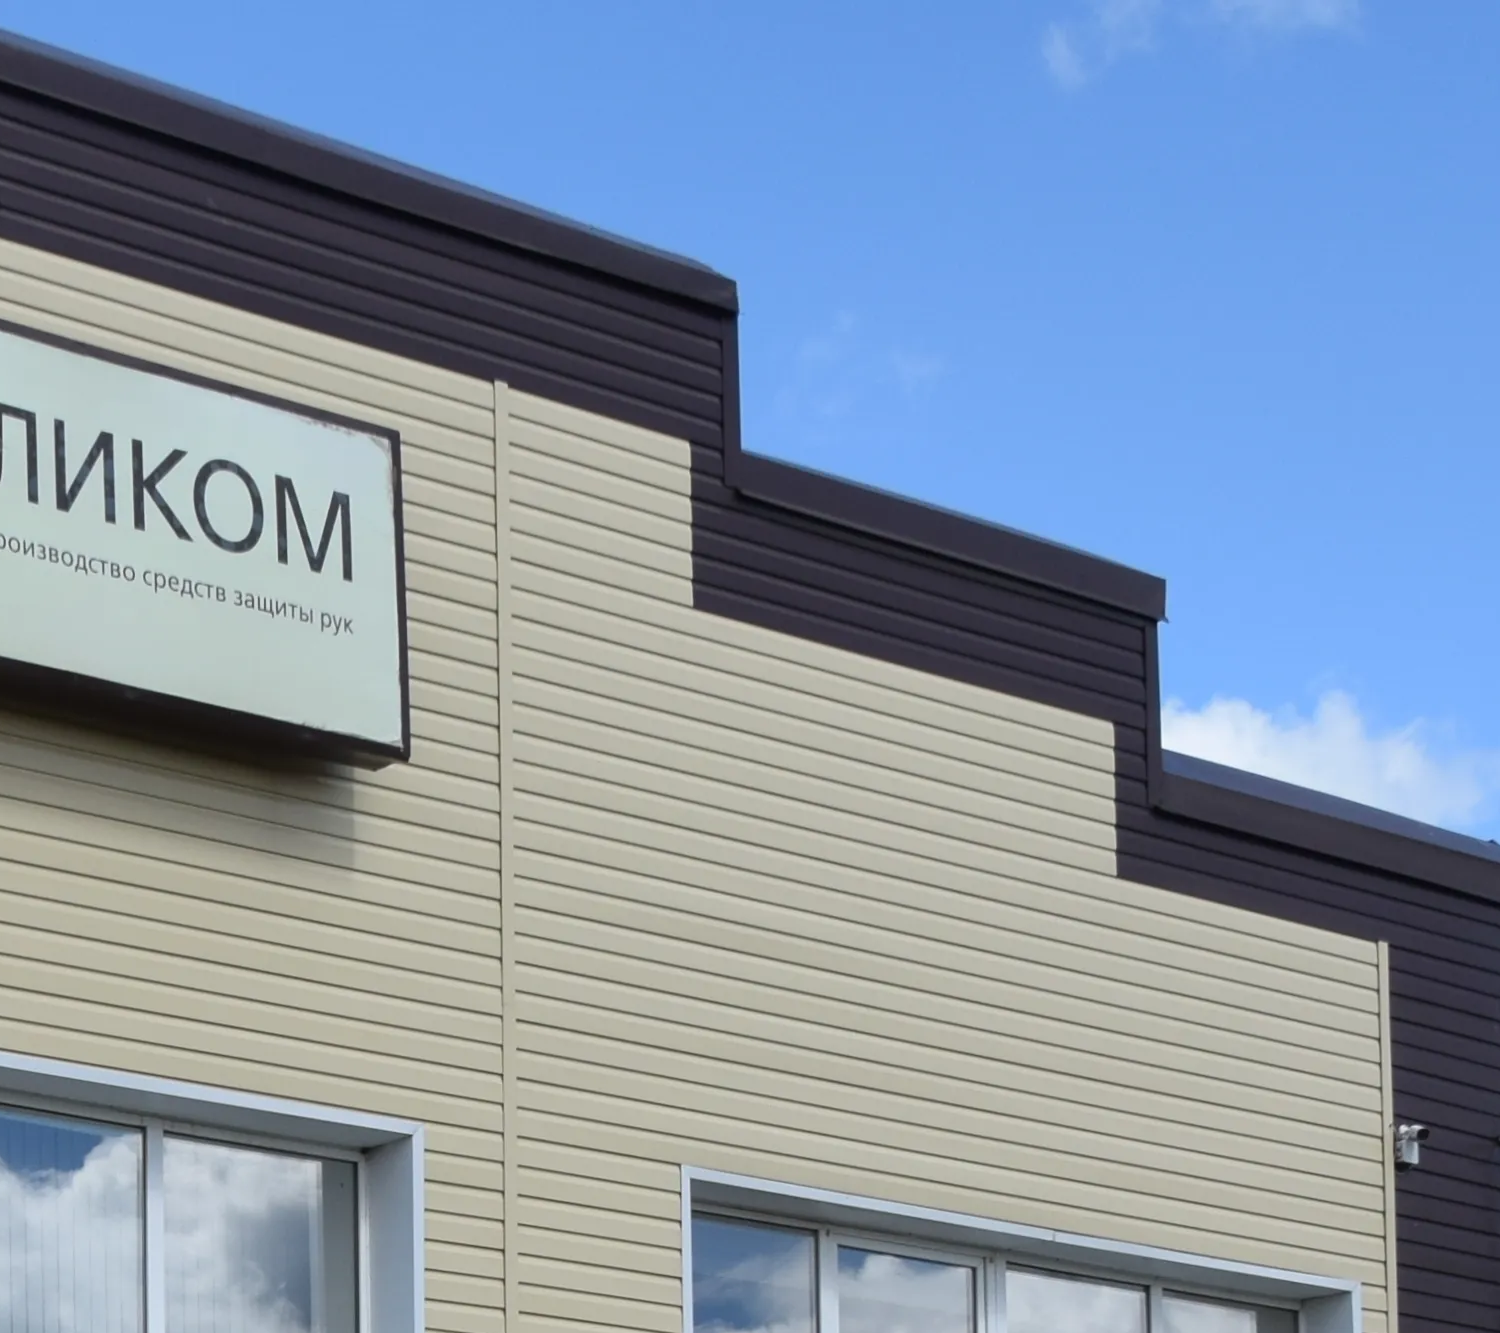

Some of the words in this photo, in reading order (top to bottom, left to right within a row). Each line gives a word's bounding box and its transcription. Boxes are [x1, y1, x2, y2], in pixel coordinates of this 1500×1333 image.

[142, 568, 226, 602] средств
[233, 589, 314, 624] защиты
[320, 611, 354, 636] рук
